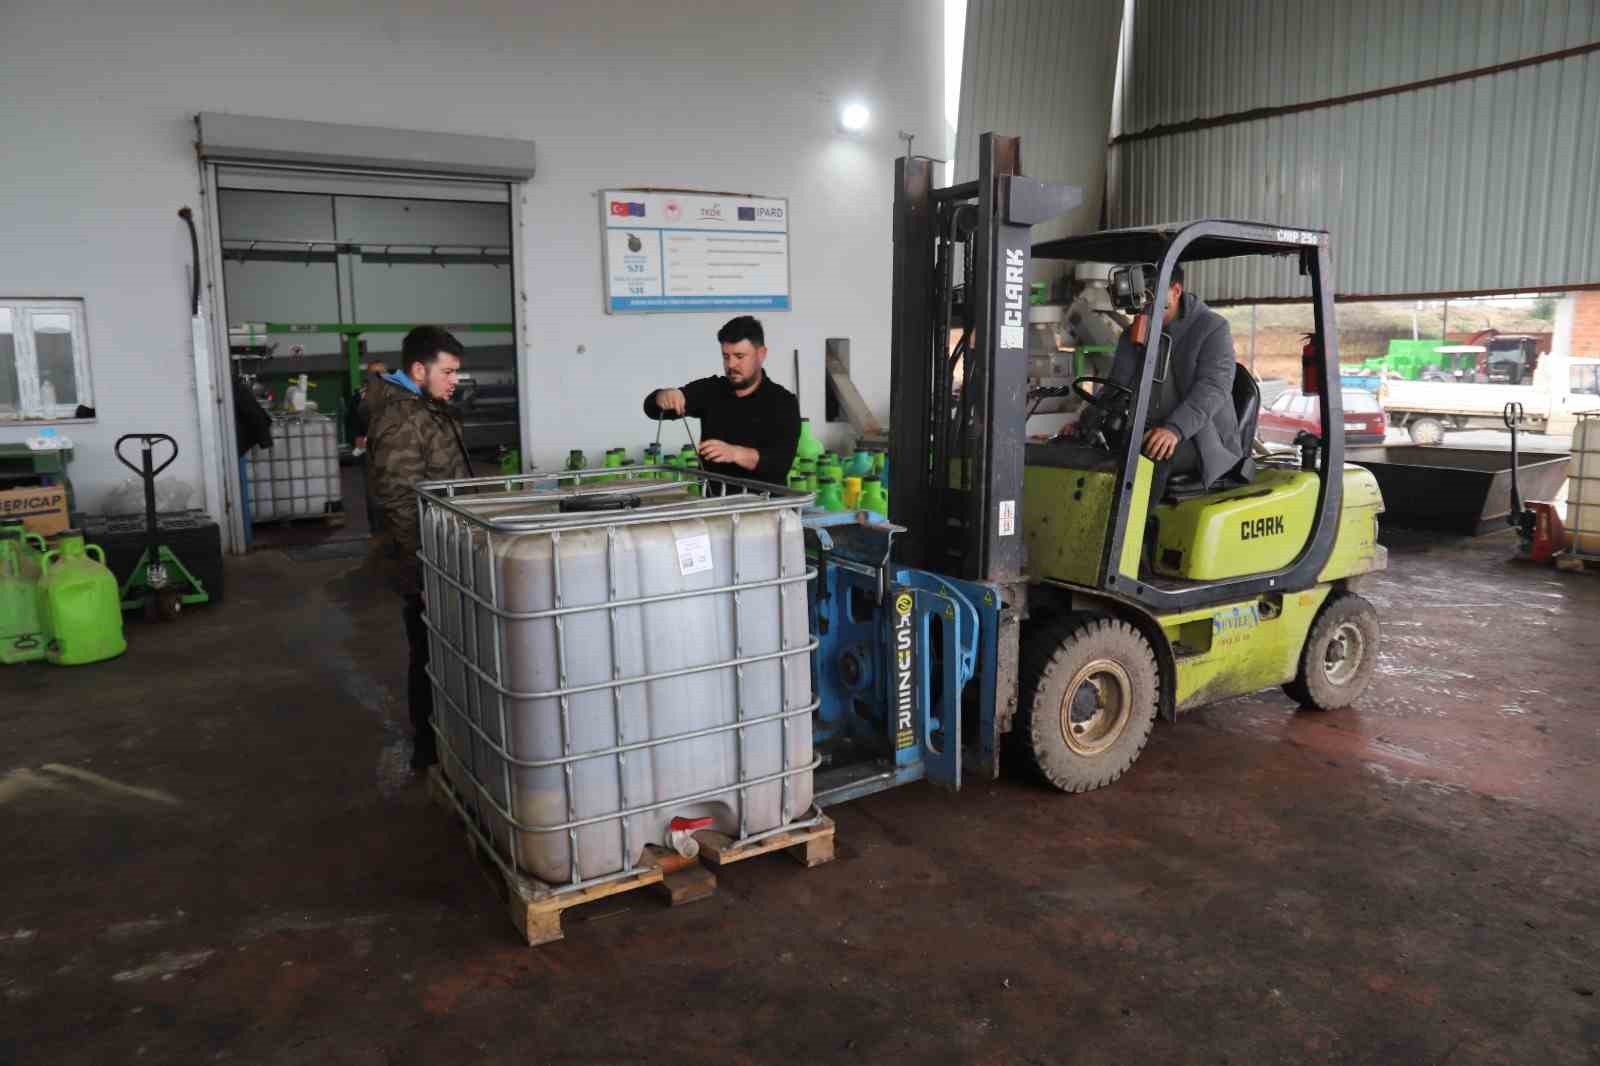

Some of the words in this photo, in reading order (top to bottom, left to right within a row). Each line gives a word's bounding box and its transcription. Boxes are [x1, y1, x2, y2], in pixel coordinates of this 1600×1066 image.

[756, 207, 785, 218] IPARD
[1004, 248, 1024, 327] CLARK
[0, 496, 61, 511] ERICAP
[1240, 515, 1284, 541] CLARK
